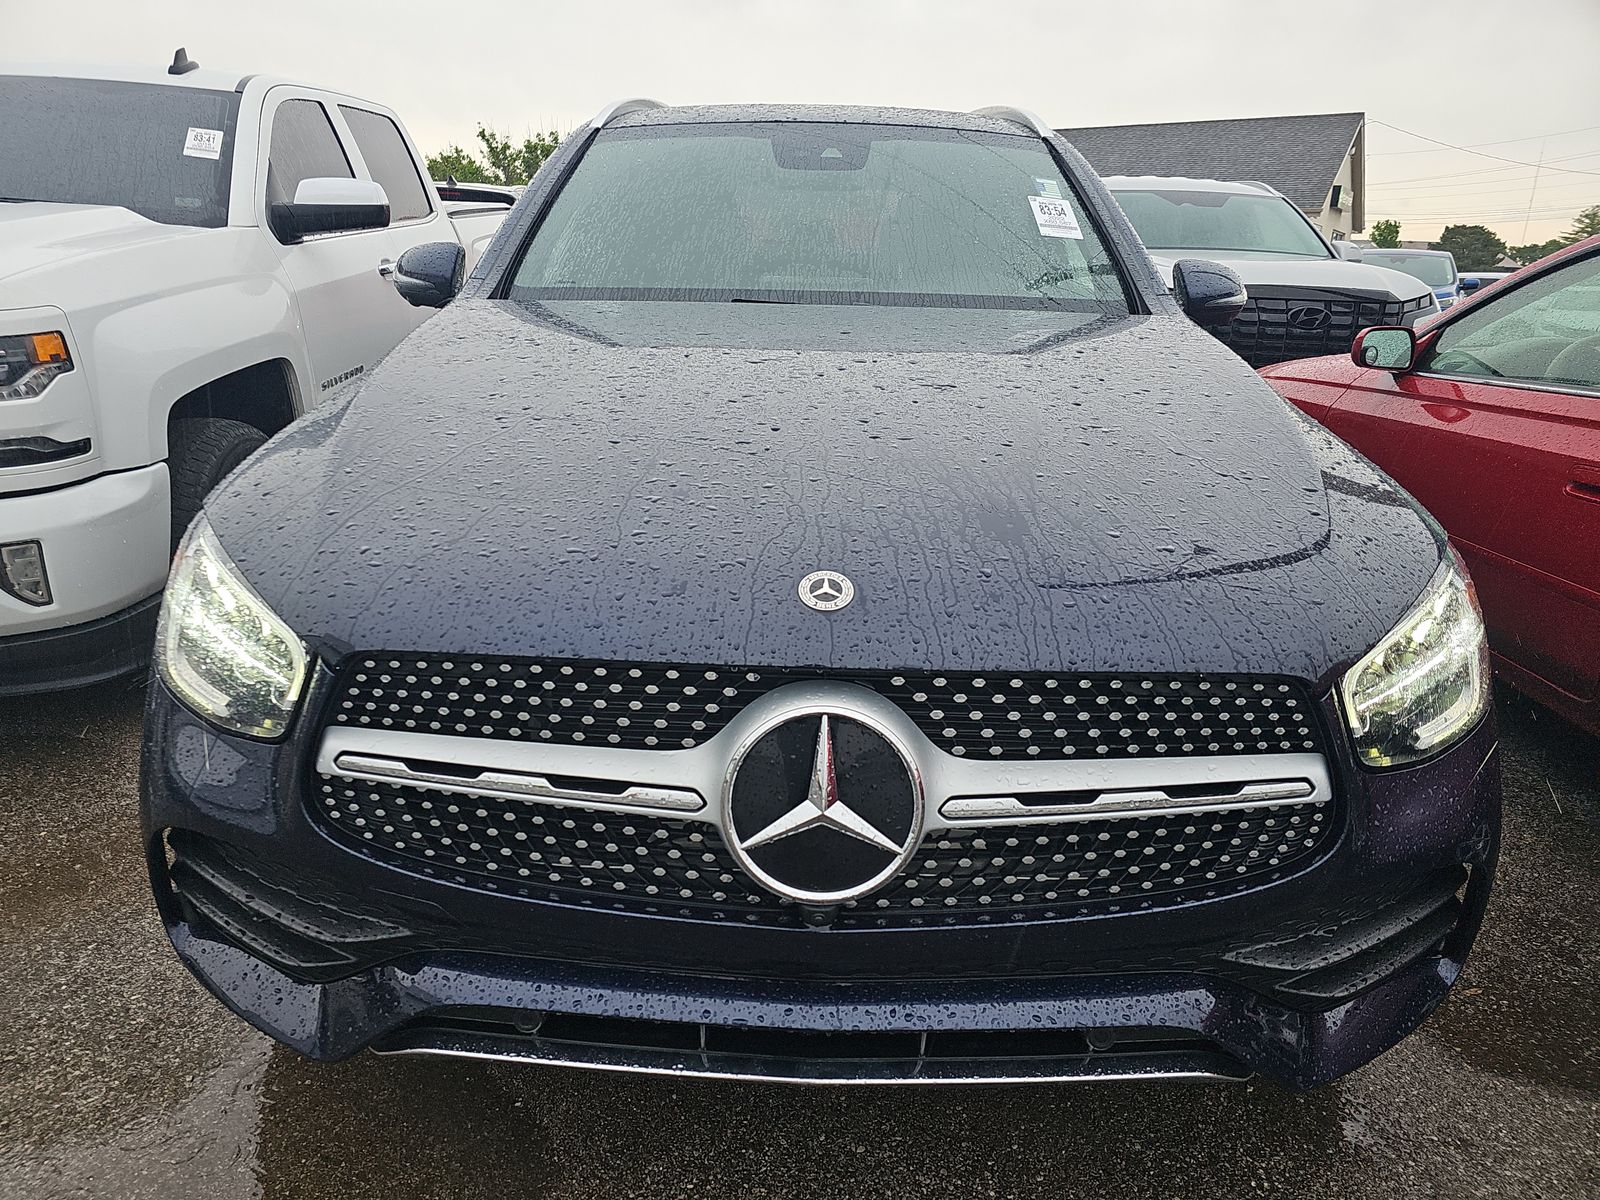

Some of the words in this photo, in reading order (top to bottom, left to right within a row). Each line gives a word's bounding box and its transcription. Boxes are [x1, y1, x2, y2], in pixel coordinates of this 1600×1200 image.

[193, 134, 216, 144] 83:41
[1038, 204, 1067, 217] 83:54
[321, 364, 364, 392] SILVERADO
